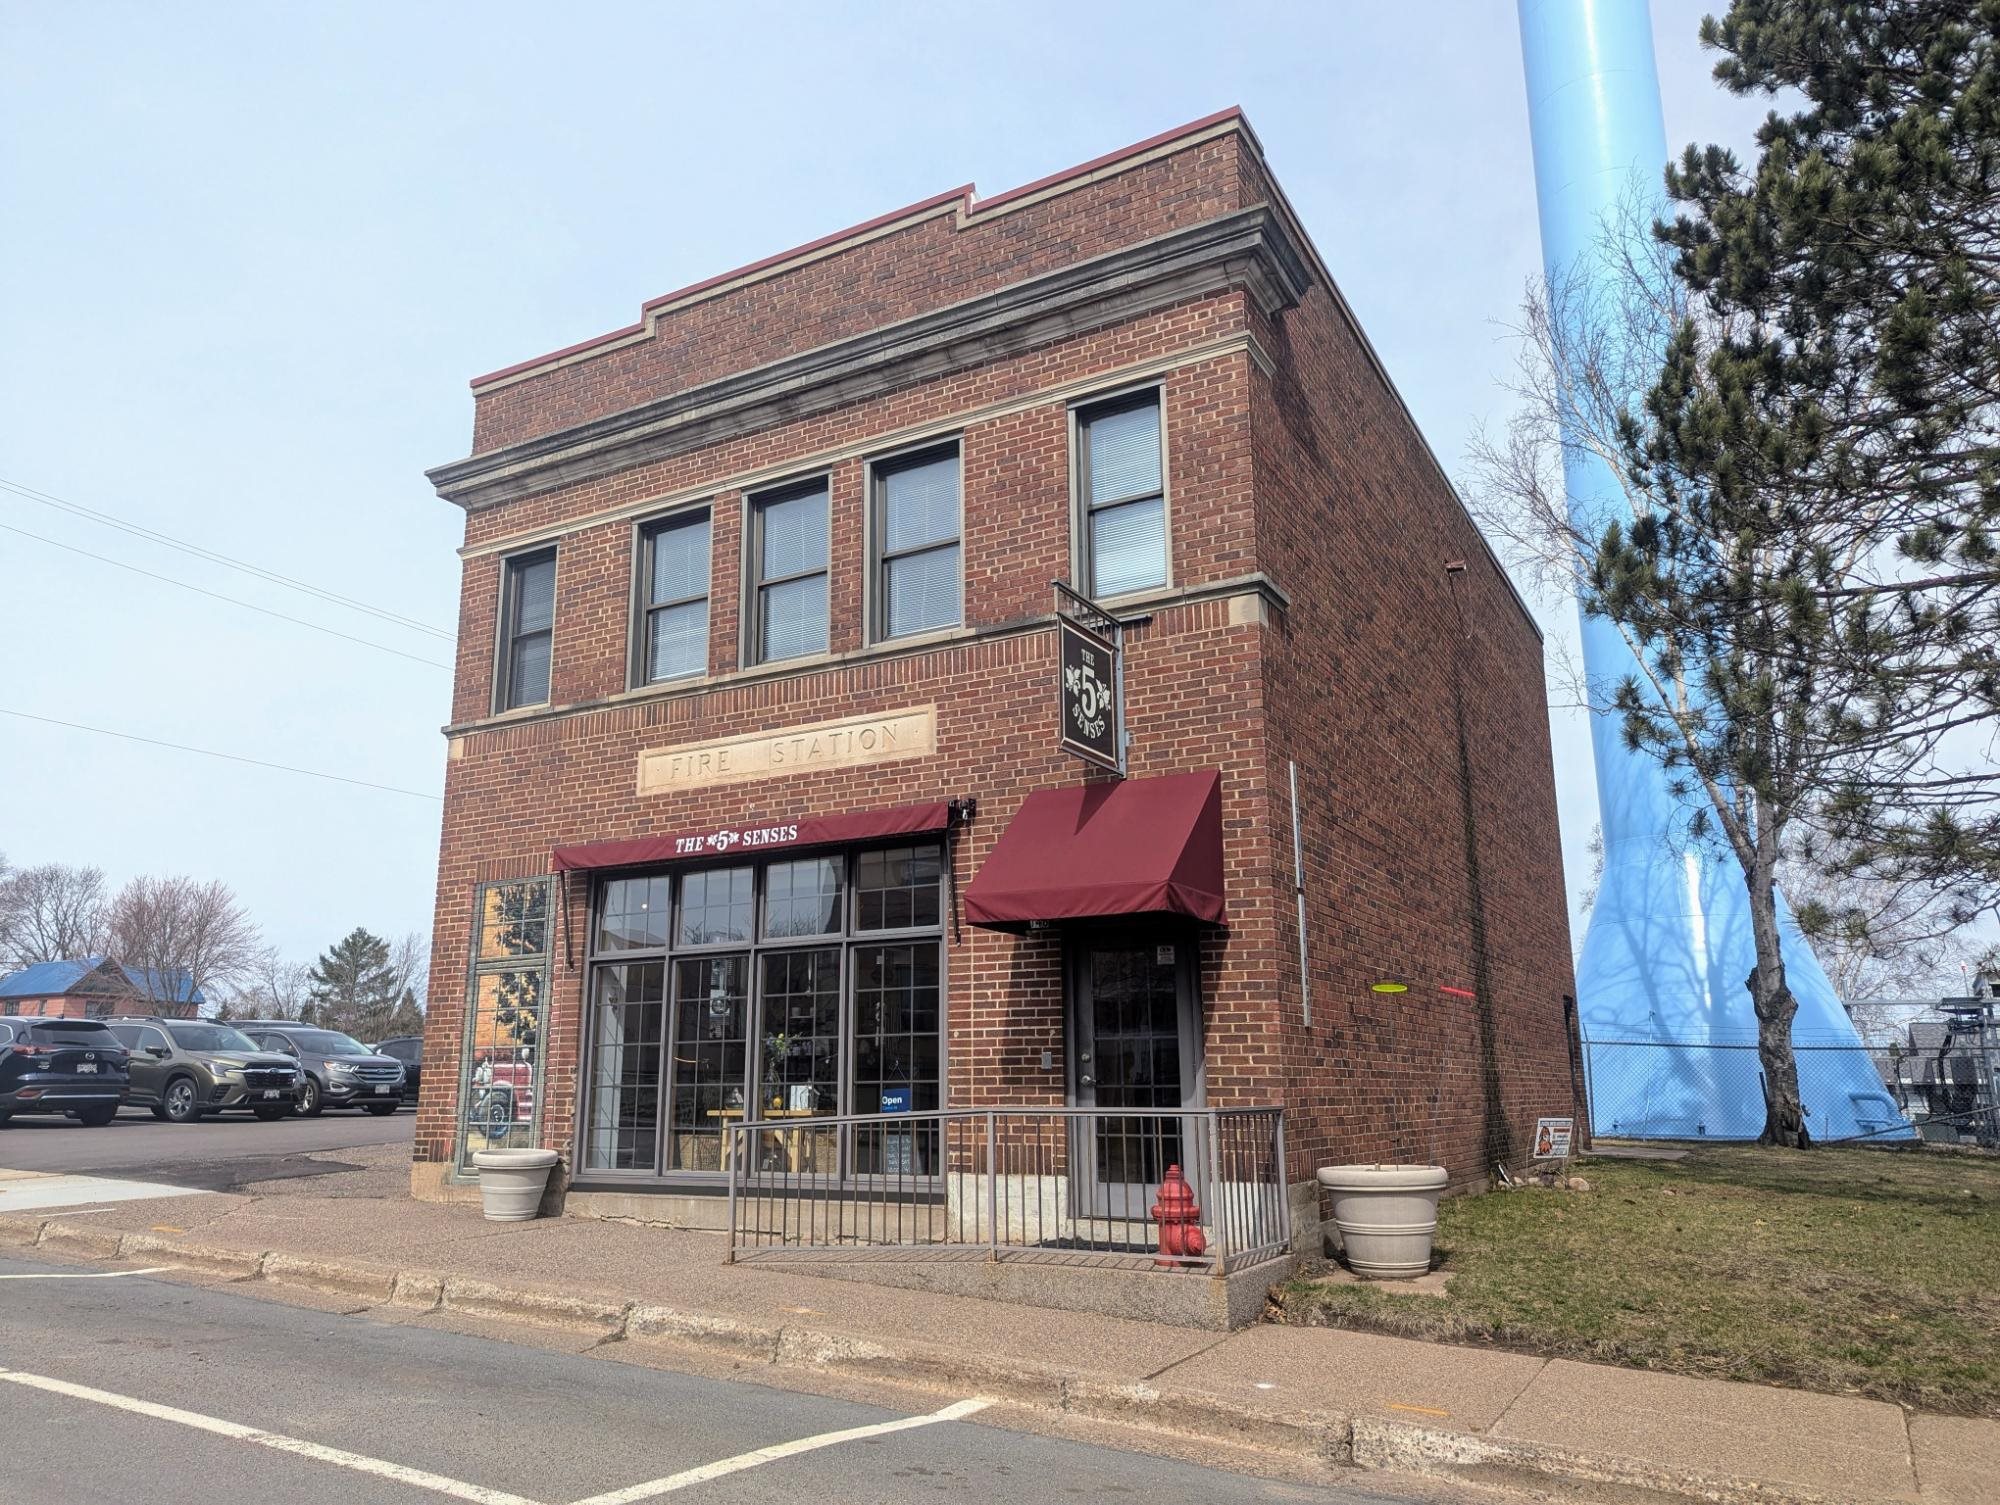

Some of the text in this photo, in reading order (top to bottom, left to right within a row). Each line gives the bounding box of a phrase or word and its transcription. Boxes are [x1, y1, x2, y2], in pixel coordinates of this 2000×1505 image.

[1081, 648, 1095, 666] THE
[1081, 664, 1097, 718] 5
[1072, 703, 1106, 739] SENSES
[670, 723, 898, 780] FIRE STATION
[675, 825, 798, 853] THE 5 SENSES
[881, 1096, 902, 1105] Open
